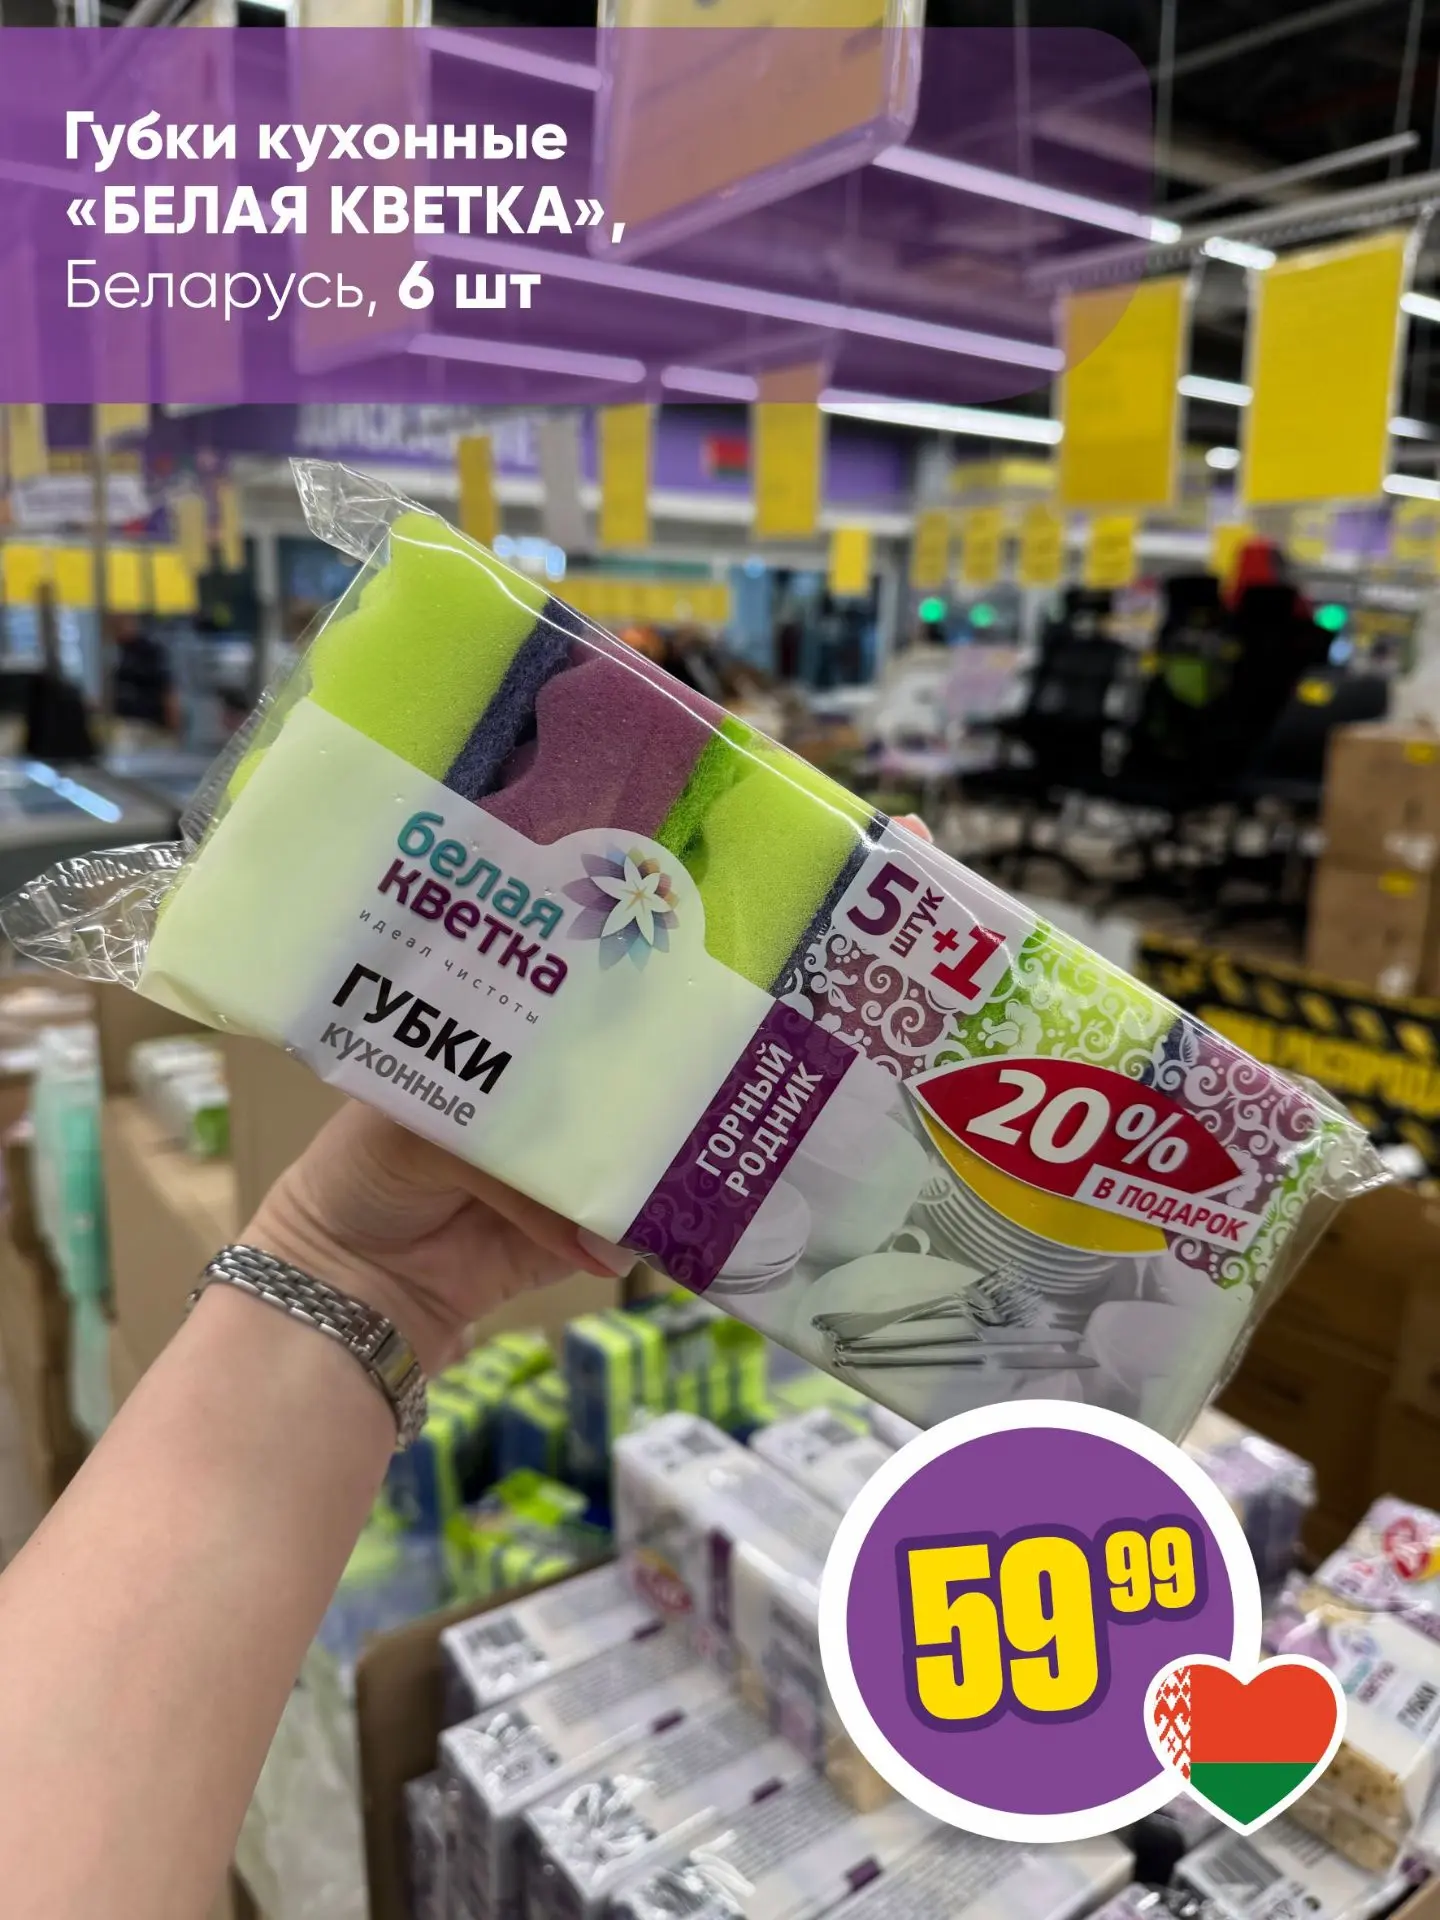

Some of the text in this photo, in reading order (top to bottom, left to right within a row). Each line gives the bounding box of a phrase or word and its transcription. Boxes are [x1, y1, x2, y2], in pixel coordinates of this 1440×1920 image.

[377, 858, 569, 996] кветка
[396, 811, 565, 940] белая
[847, 862, 920, 936] 5
[889, 887, 944, 958] штук
[332, 963, 513, 1094] ГУБКИ
[359, 908, 539, 1024] идеал чистоты
[319, 1022, 476, 1126] кухонные
[695, 1040, 792, 1178] ГОРНЫЙ
[725, 1068, 824, 1196] РОДНИК
[1093, 1177, 1248, 1241] В ПОДАРОК
